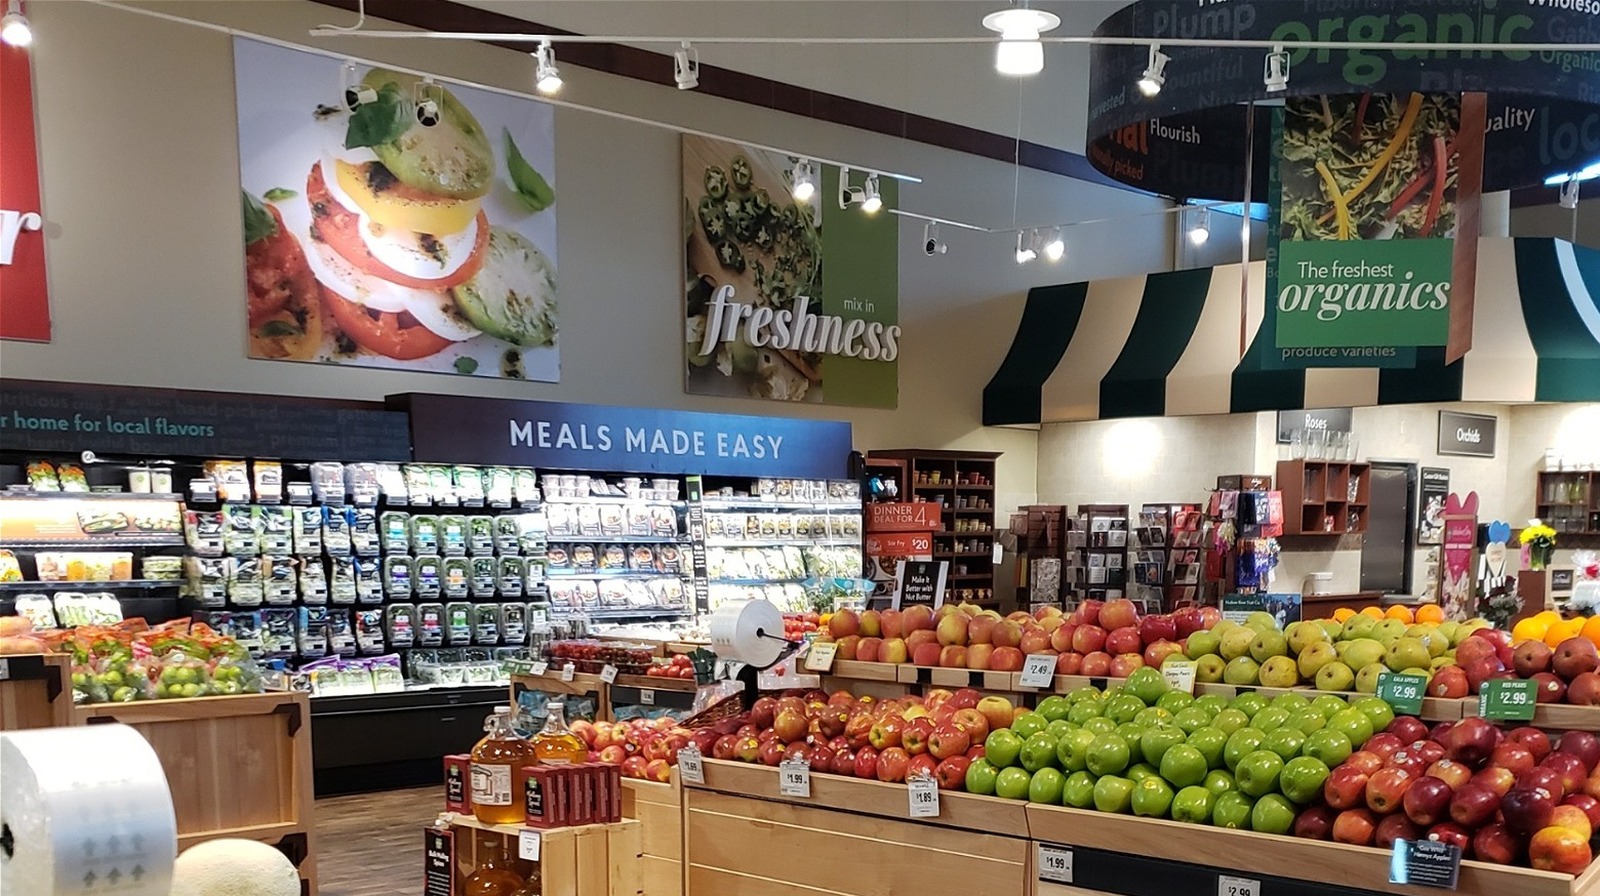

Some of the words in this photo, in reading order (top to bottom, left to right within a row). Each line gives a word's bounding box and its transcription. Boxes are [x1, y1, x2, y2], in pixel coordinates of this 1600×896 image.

[1269, 0, 1534, 86] organic
[1150, 117, 1200, 145] Flourish
[1297, 260, 1328, 279] The
[1331, 259, 1395, 279] freshest
[1278, 270, 1452, 322] organics
[844, 297, 863, 313] mix
[866, 299, 875, 314] in
[699, 284, 902, 363] freshness
[1281, 346, 1338, 362] produce
[1342, 345, 1397, 358] varieties
[13, 410, 70, 431] home
[74, 412, 103, 433] for
[106, 414, 152, 435] local
[154, 417, 215, 438] flavors
[1305, 413, 1327, 431] Roses
[508, 418, 613, 452] MEALS
[625, 427, 706, 457] MADE
[716, 432, 784, 460] EASY
[1456, 427, 1482, 444] Orchids
[874, 506, 912, 516] DINNER
[874, 515, 895, 523] DEAL
[896, 514, 914, 523] FOR
[914, 506, 926, 526] 4
[912, 538, 929, 551] $20
[905, 584, 921, 593] Better
[922, 584, 933, 593] with
[911, 576, 925, 584] Make
[905, 593, 915, 601] Nut
[916, 593, 931, 601] Butter
[1030, 664, 1048, 675] $2.49
[1393, 684, 1416, 699] $2.99
[1500, 690, 1527, 705] $2.99
[787, 773, 803, 784] $1.99
[1046, 856, 1064, 869] $1.99
